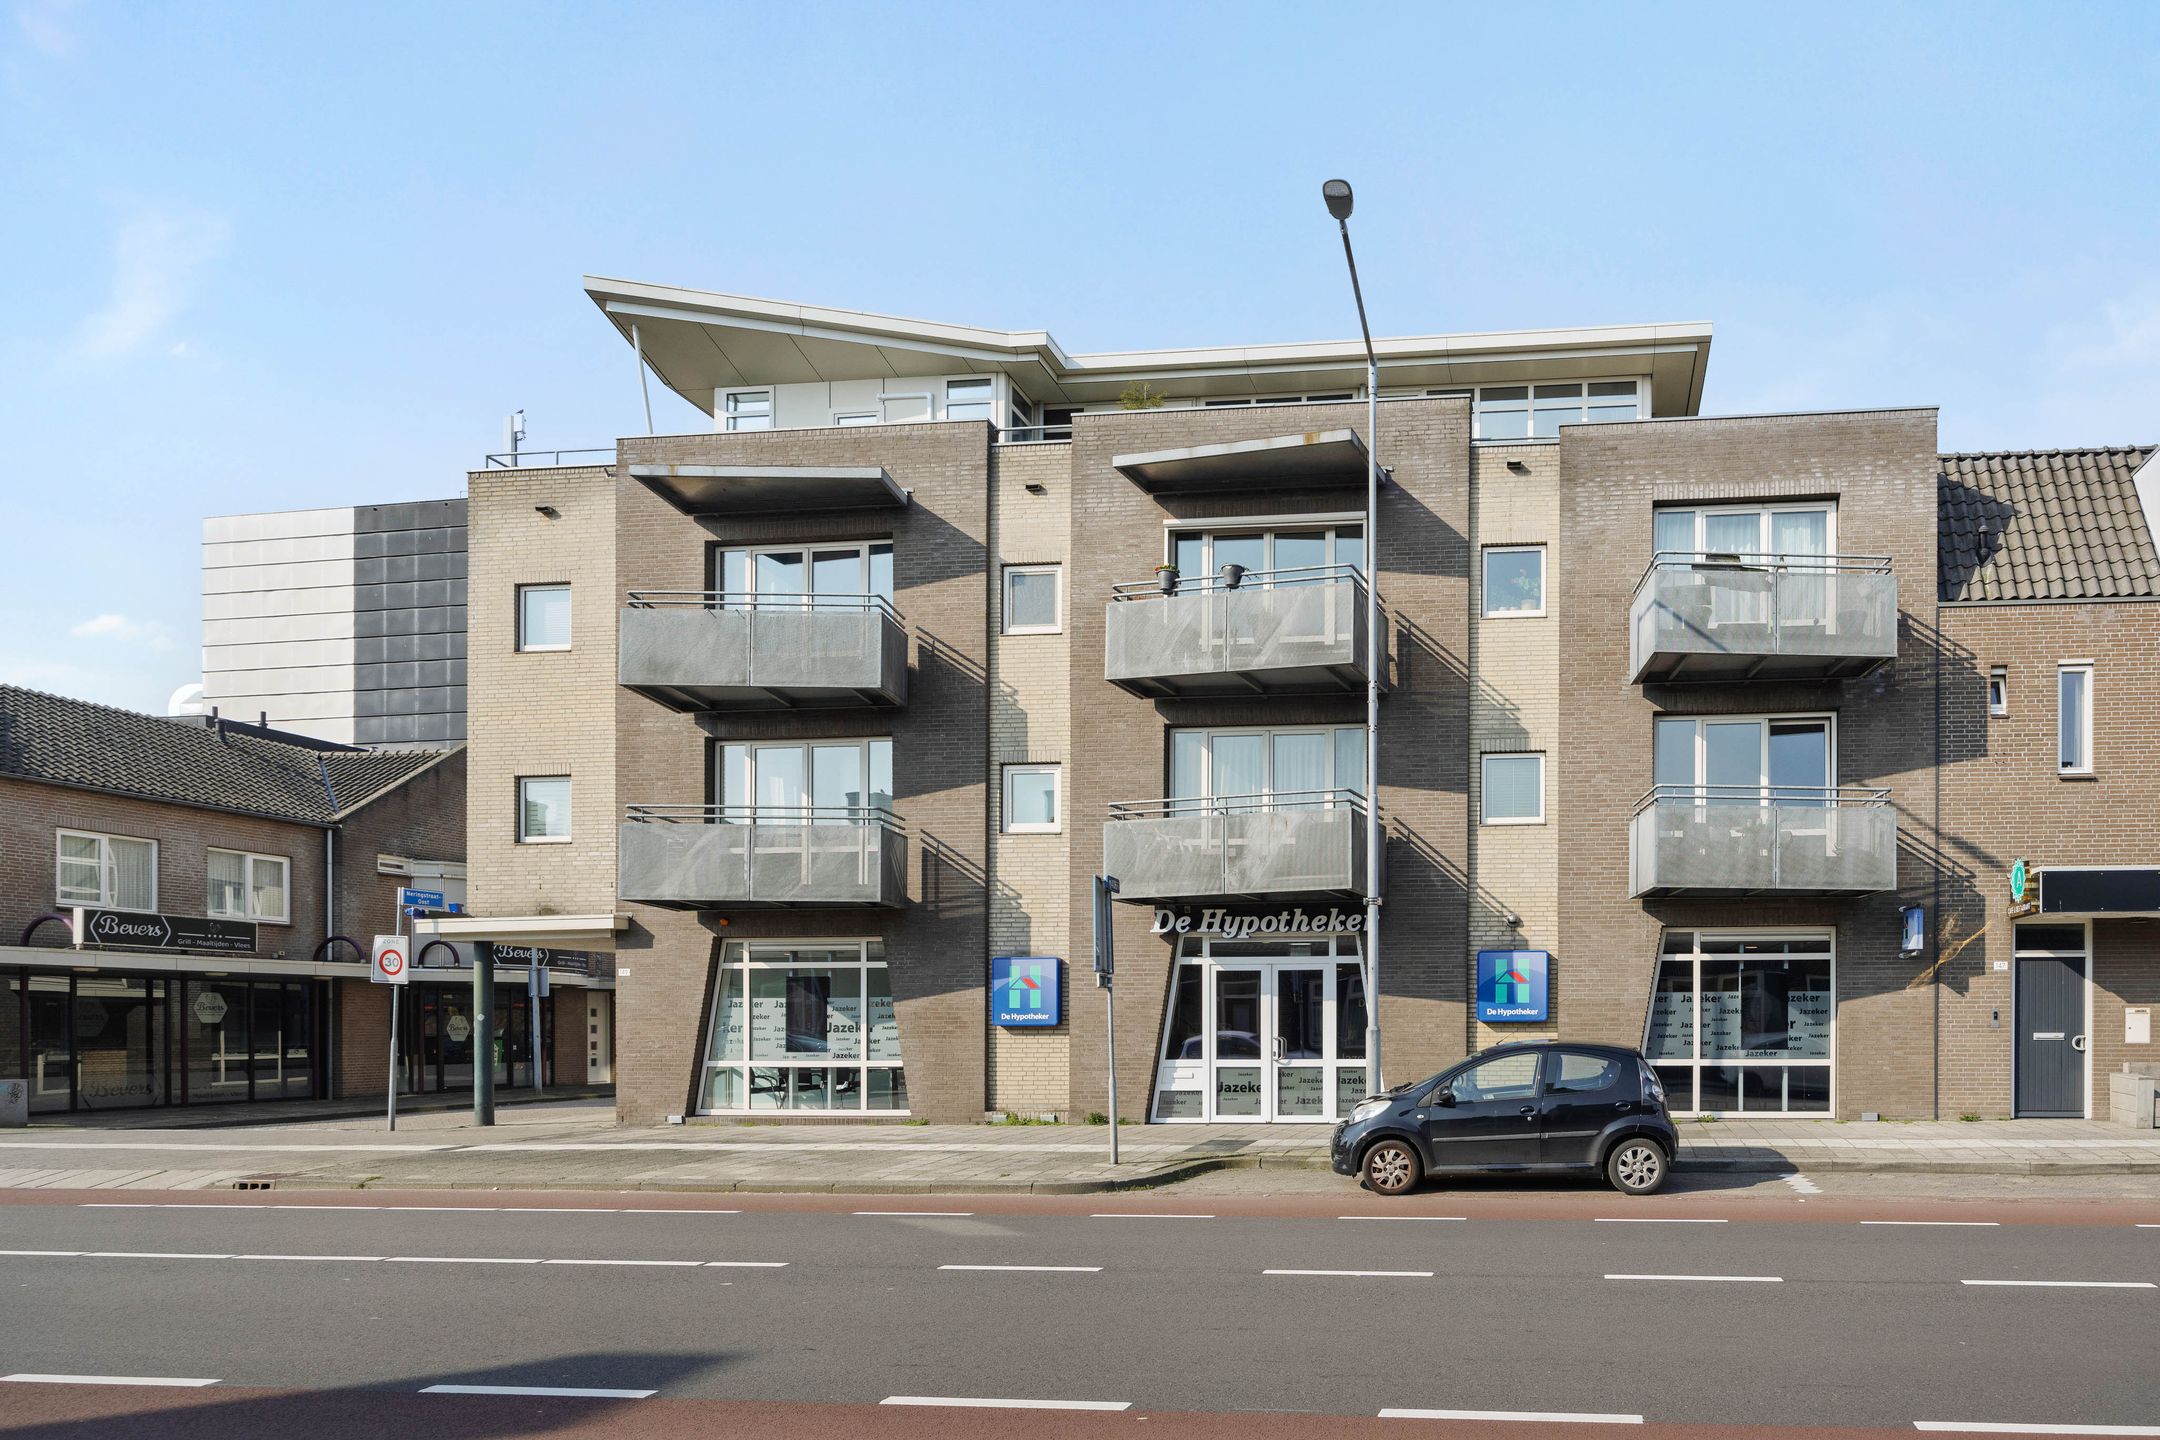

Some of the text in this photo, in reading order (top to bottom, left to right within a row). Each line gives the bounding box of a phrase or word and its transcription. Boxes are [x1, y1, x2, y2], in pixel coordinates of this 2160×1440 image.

[1150, 909, 1192, 933] De
[98, 915, 164, 937] Bevers
[196, 939, 229, 948] Maaltijden
[498, 944, 545, 960] Beves
[384, 957, 399, 968] 30
[1788, 993, 1820, 1002] zeker
[1497, 1008, 1539, 1016] Hypotheker
[1011, 1013, 1050, 1021] Hypotheker
[1745, 1049, 1778, 1057] Jazeker
[1217, 1081, 1261, 1093] Jazeke
[1295, 1096, 1322, 1105] Jazek
